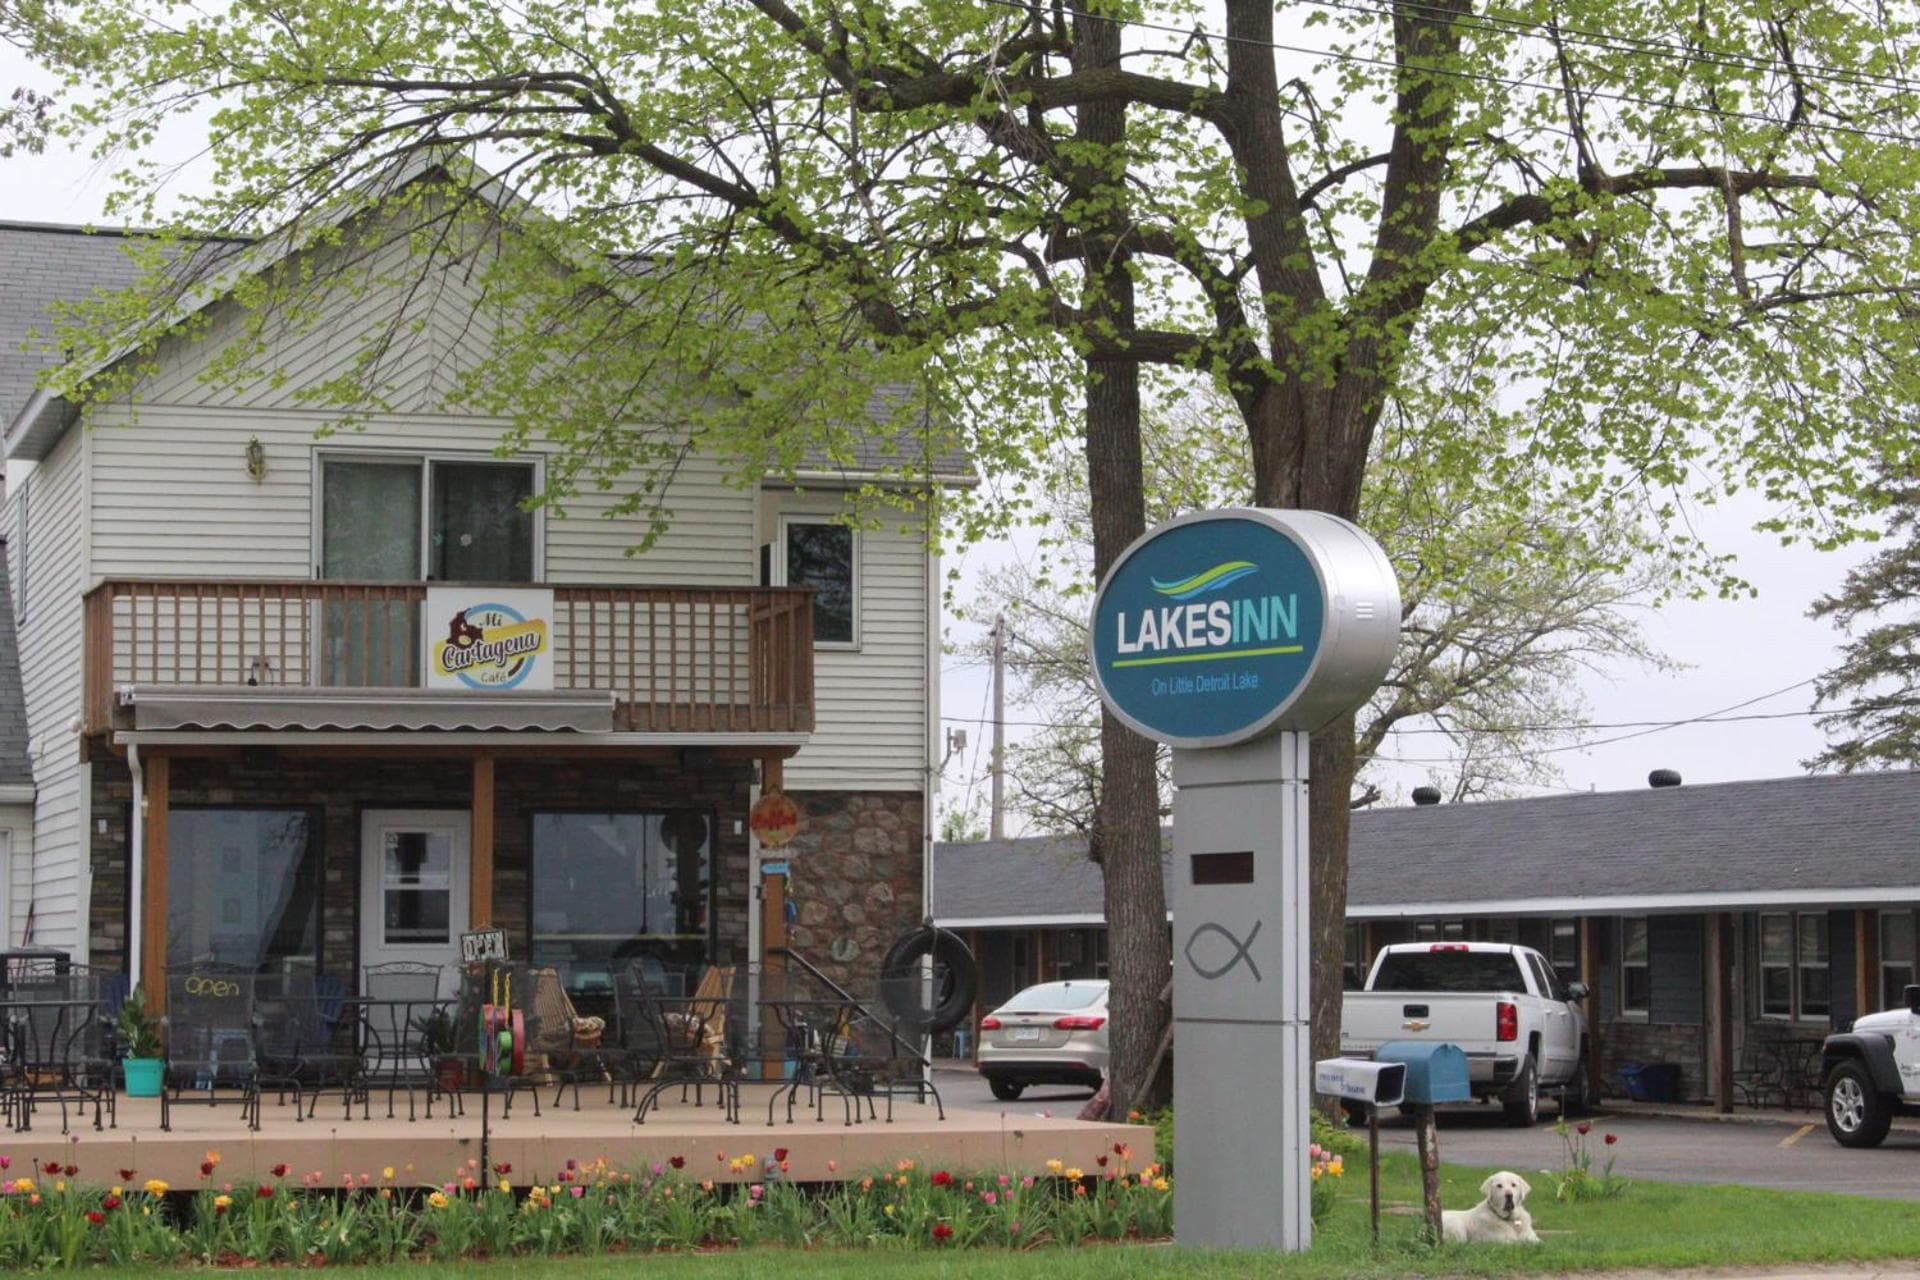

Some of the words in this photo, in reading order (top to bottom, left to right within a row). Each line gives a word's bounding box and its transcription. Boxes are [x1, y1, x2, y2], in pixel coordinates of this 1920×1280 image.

[478, 612, 502, 627] Mi
[442, 631, 542, 672] Cartagena
[1151, 678, 1168, 696] On
[1169, 676, 1194, 695] Little
[1196, 674, 1230, 693] Detroit
[1232, 671, 1258, 690] Lake
[463, 932, 503, 960] OPEN
